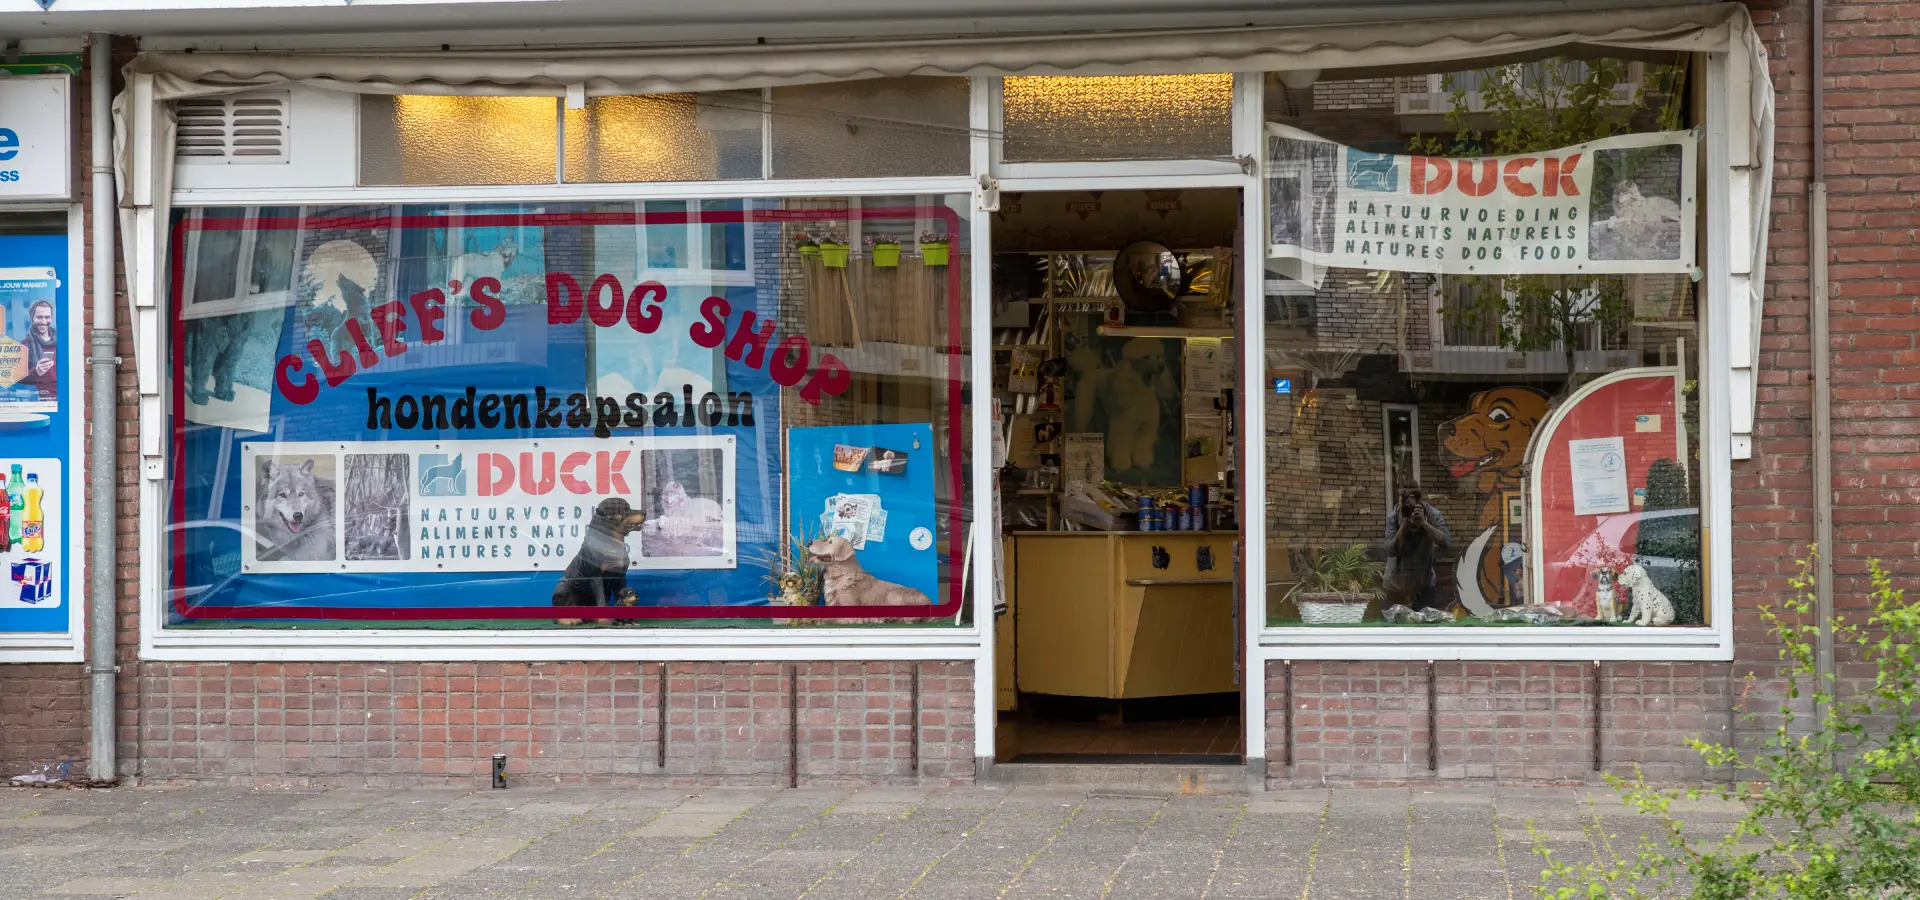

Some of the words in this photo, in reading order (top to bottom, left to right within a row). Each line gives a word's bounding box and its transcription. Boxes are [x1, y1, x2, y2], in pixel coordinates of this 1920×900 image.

[0, 128, 19, 160] e
[0, 170, 19, 182] ss
[1410, 153, 1583, 197] DUCK
[1349, 200, 1577, 222] NATUURVOEDING
[1346, 219, 1452, 240] ALIMENTS
[1467, 225, 1576, 241] NATURELS
[1346, 240, 1444, 259] NATURES
[1462, 246, 1503, 260] DOG
[1520, 246, 1577, 260] FOOD
[545, 272, 667, 334] DOG
[690, 296, 851, 407] SHOP
[366, 384, 755, 438] hondenkapsalon
[477, 450, 632, 497] DUCK
[421, 525, 518, 540] ALIMENTS
[421, 544, 512, 559] NATURES
[528, 543, 565, 558] DOG
